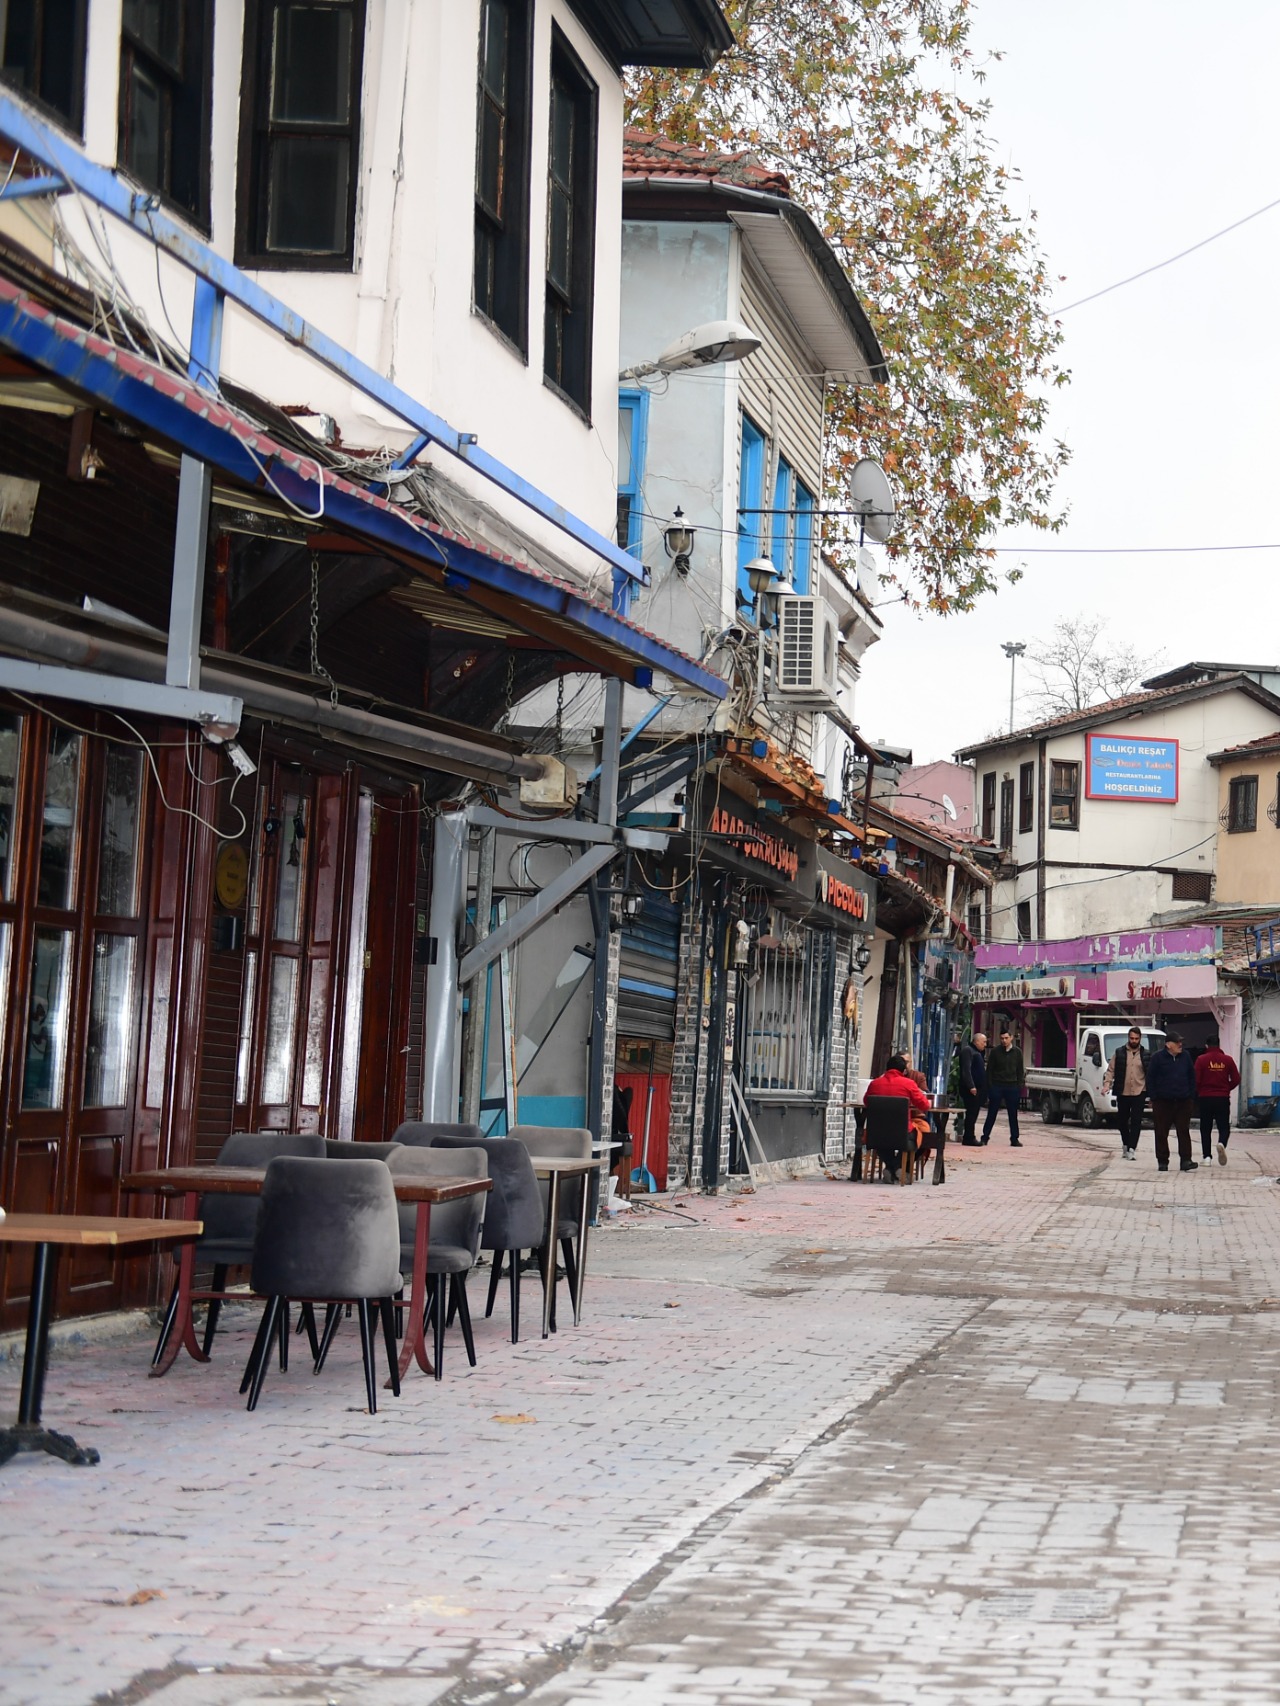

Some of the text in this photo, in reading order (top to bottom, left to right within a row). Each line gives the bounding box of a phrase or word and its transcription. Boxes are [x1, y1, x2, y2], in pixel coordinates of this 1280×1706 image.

[1100, 744, 1167, 757] BALIKÇI REŞAT
[1105, 772, 1162, 780] RESTAURANTLARINA
[1104, 783, 1163, 794] HOŞGELDİNİZ
[828, 874, 863, 919] PICCOLO
